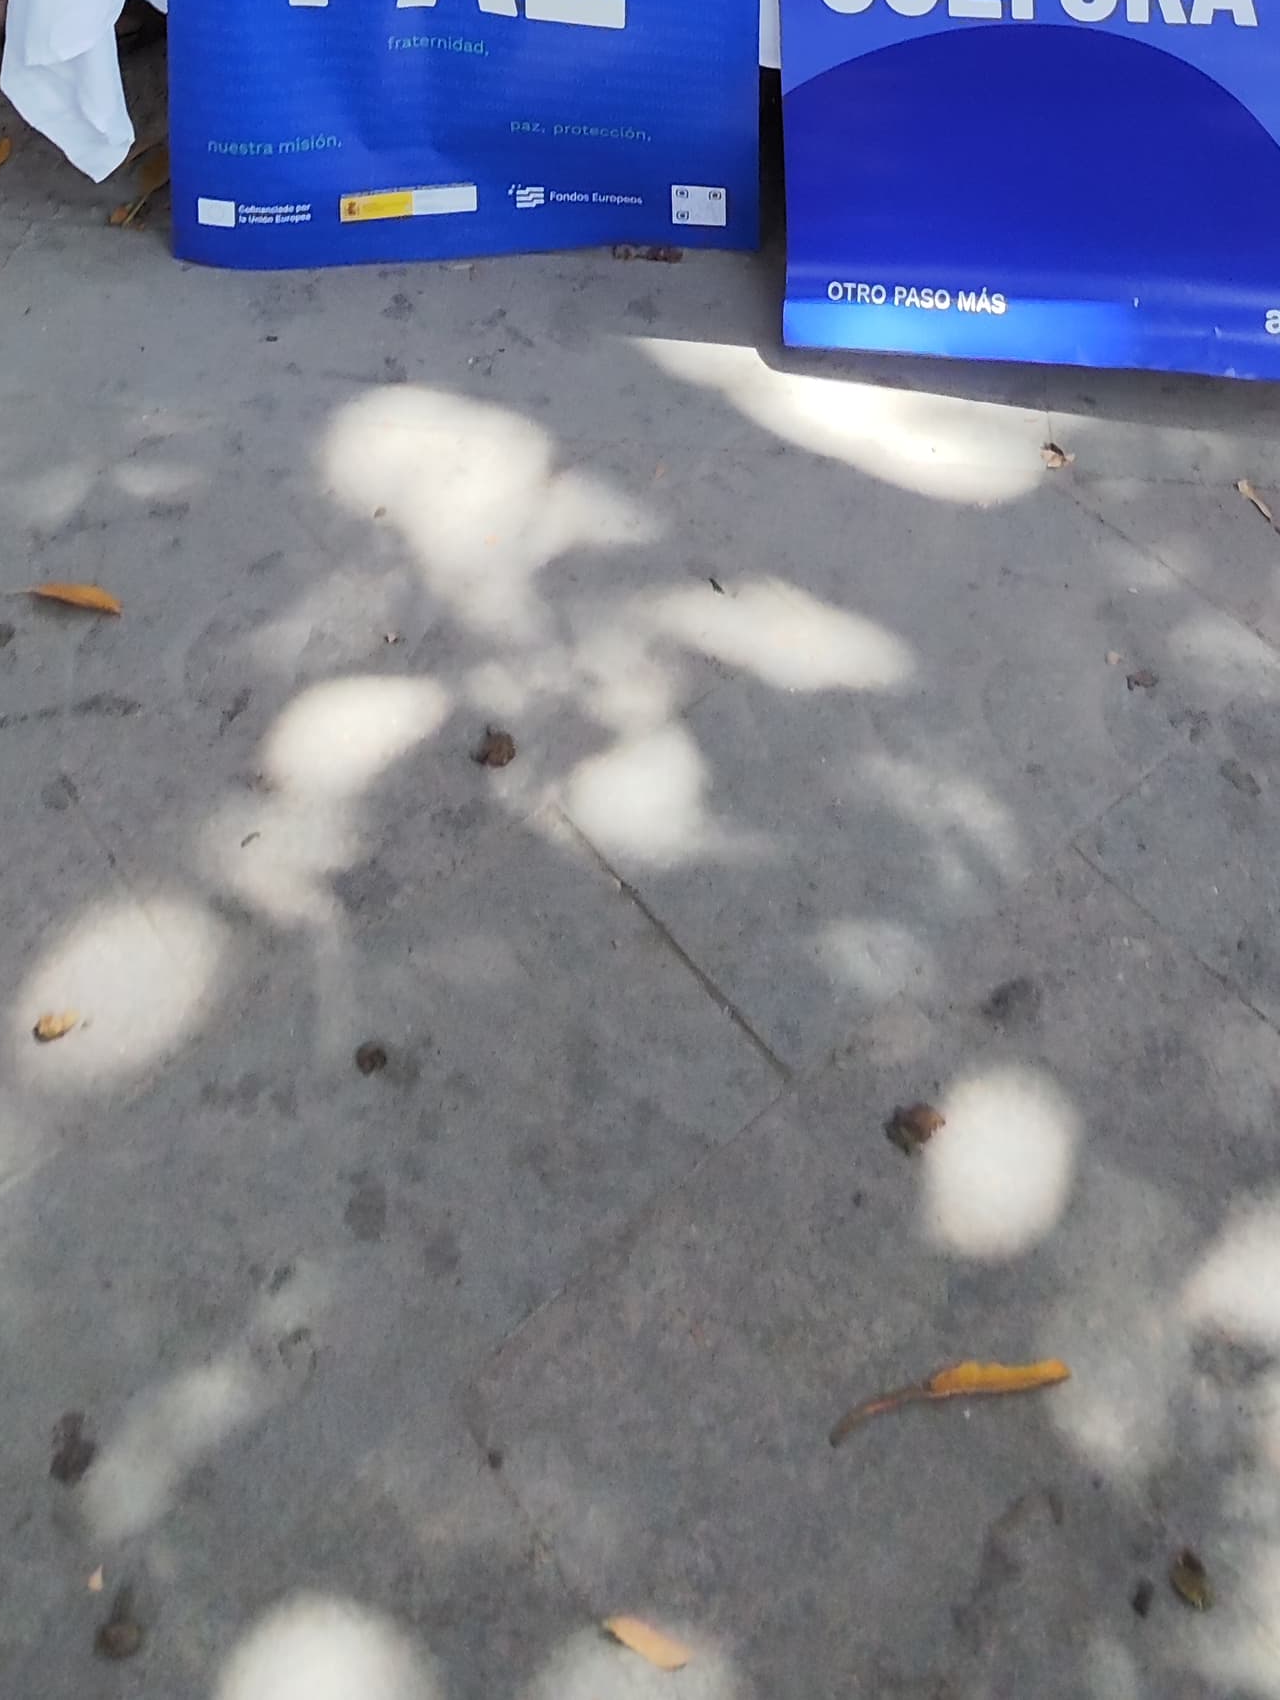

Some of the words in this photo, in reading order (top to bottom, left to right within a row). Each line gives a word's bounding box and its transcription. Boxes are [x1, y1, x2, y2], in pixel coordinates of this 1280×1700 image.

[388, 35, 489, 56] fraternidad,
[554, 120, 652, 143] protección,
[209, 140, 274, 156] nuestra
[278, 133, 342, 154] misión,
[550, 191, 589, 202] Fondos
[592, 192, 642, 205] Europeos
[827, 281, 887, 305] OTRO
[894, 286, 951, 311] PASO
[957, 287, 1006, 314] MÁS
